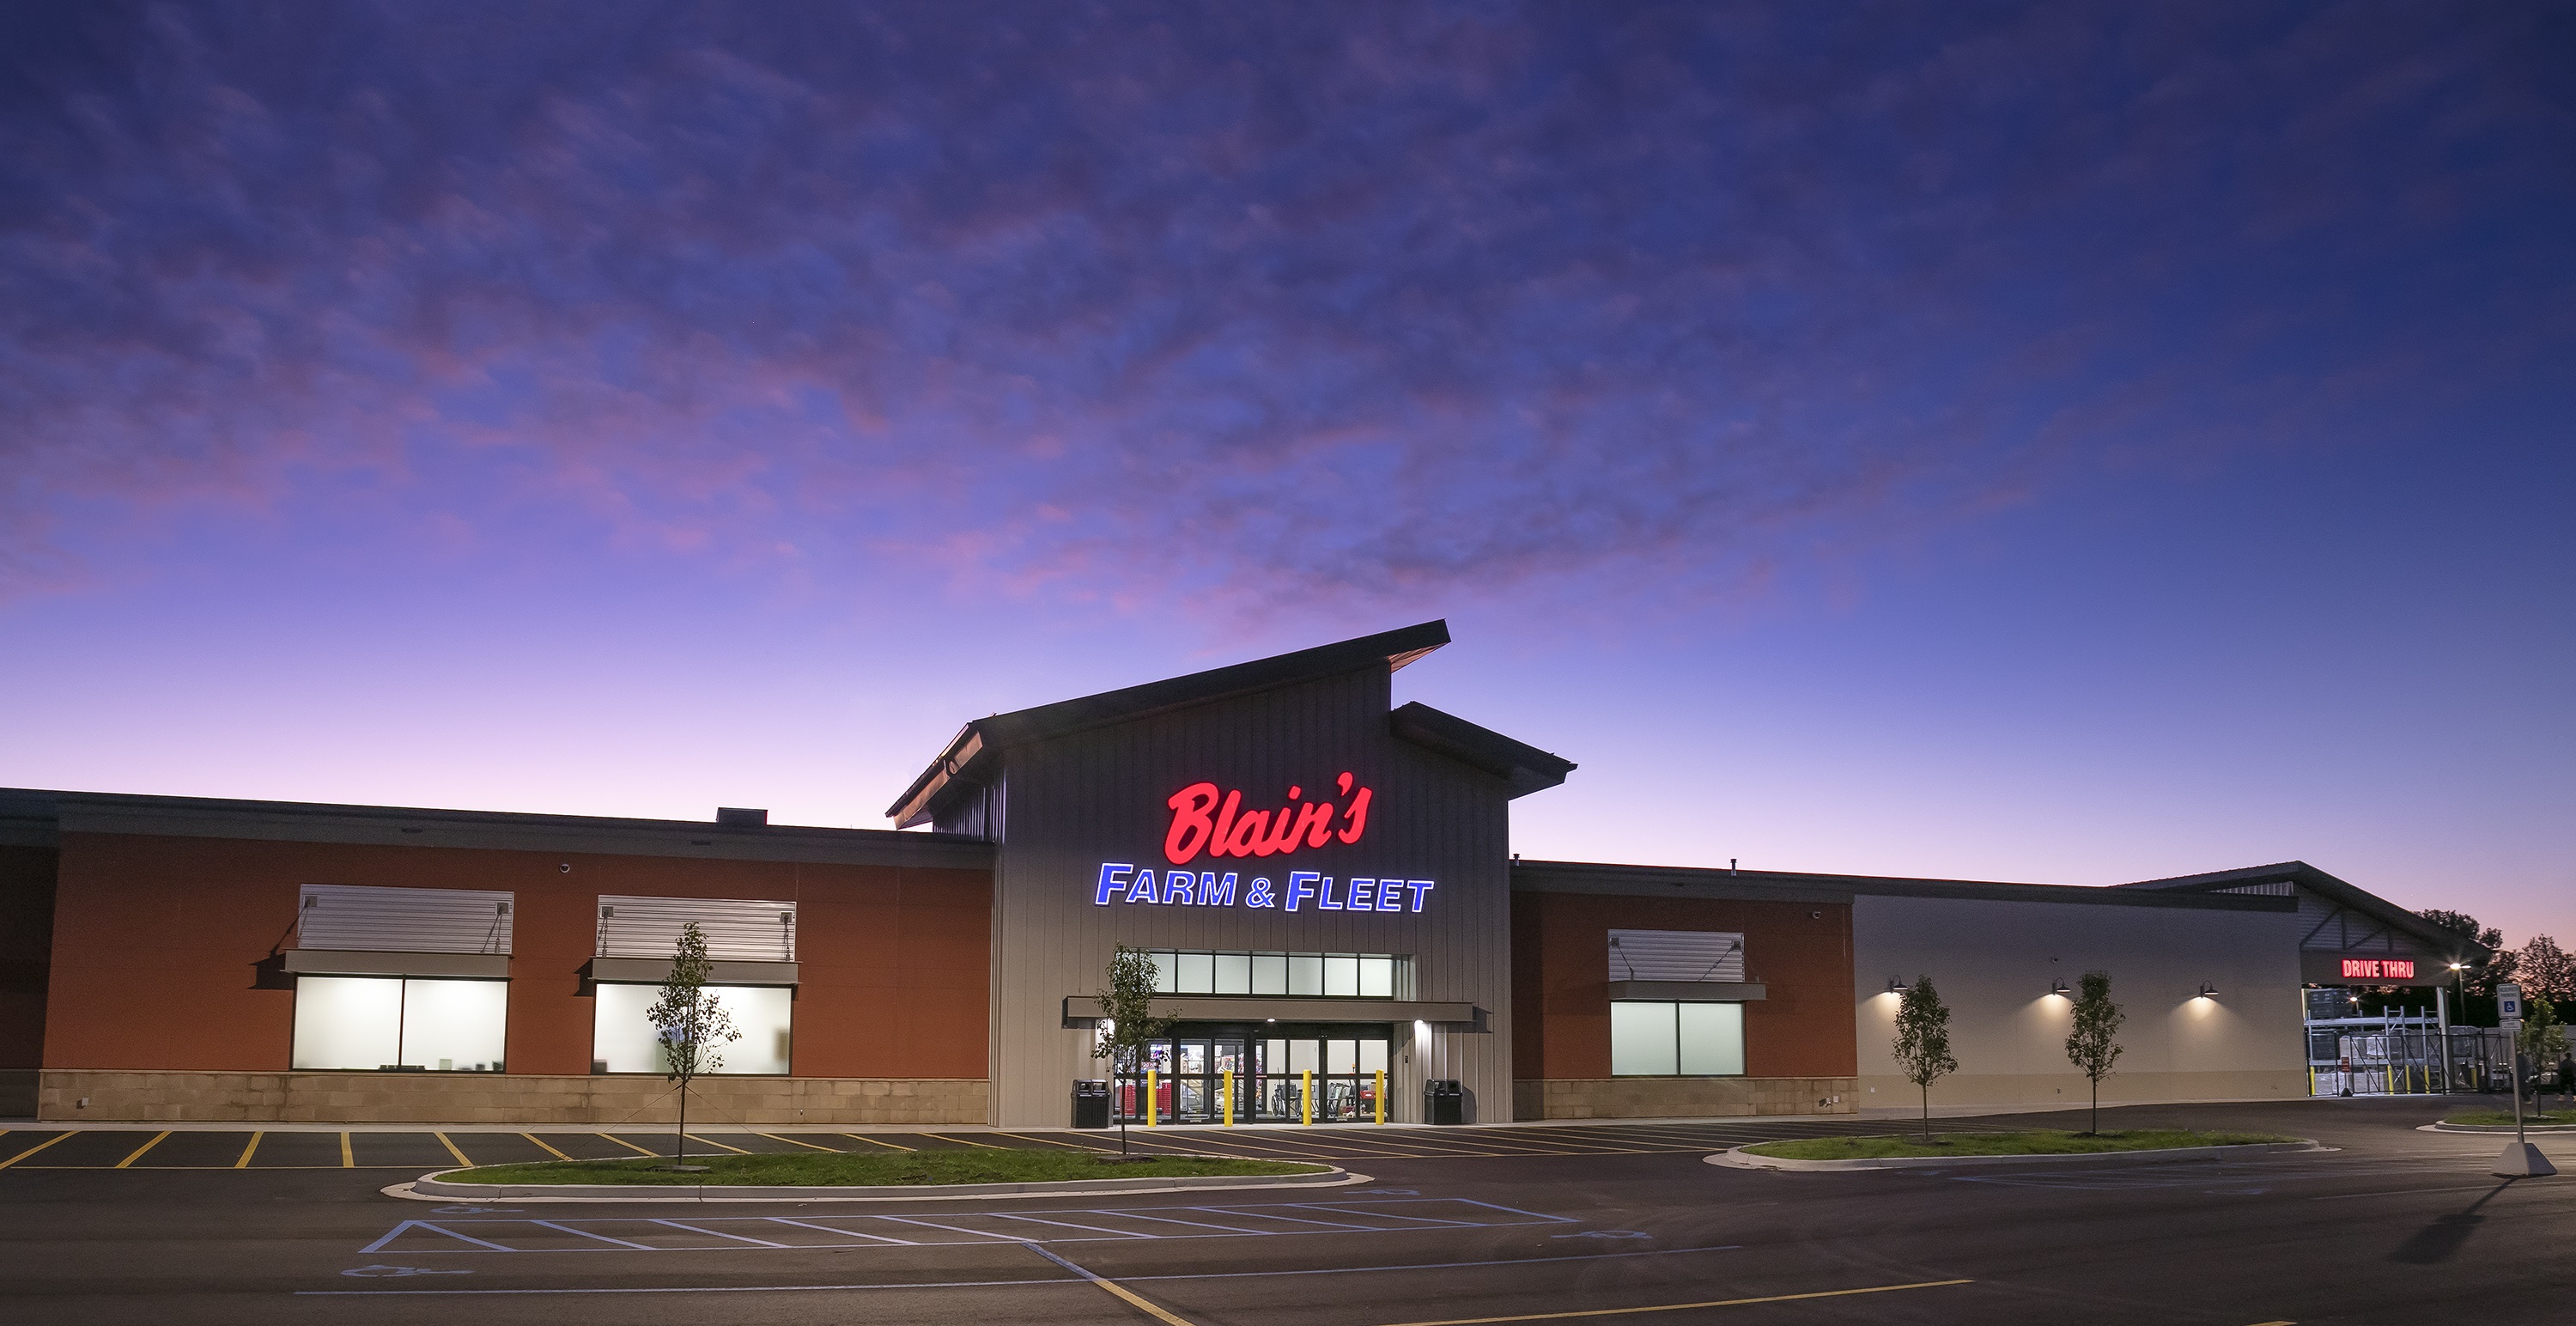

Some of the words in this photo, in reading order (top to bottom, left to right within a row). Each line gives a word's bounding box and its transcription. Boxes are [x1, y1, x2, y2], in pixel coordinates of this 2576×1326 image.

[1164, 771, 1372, 865] Blain's
[1095, 862, 1238, 906] FARM
[1246, 877, 1276, 908] &
[1285, 871, 1434, 912] FLEET
[2342, 959, 2379, 978] DRIVE
[2381, 960, 2415, 979] THRU
